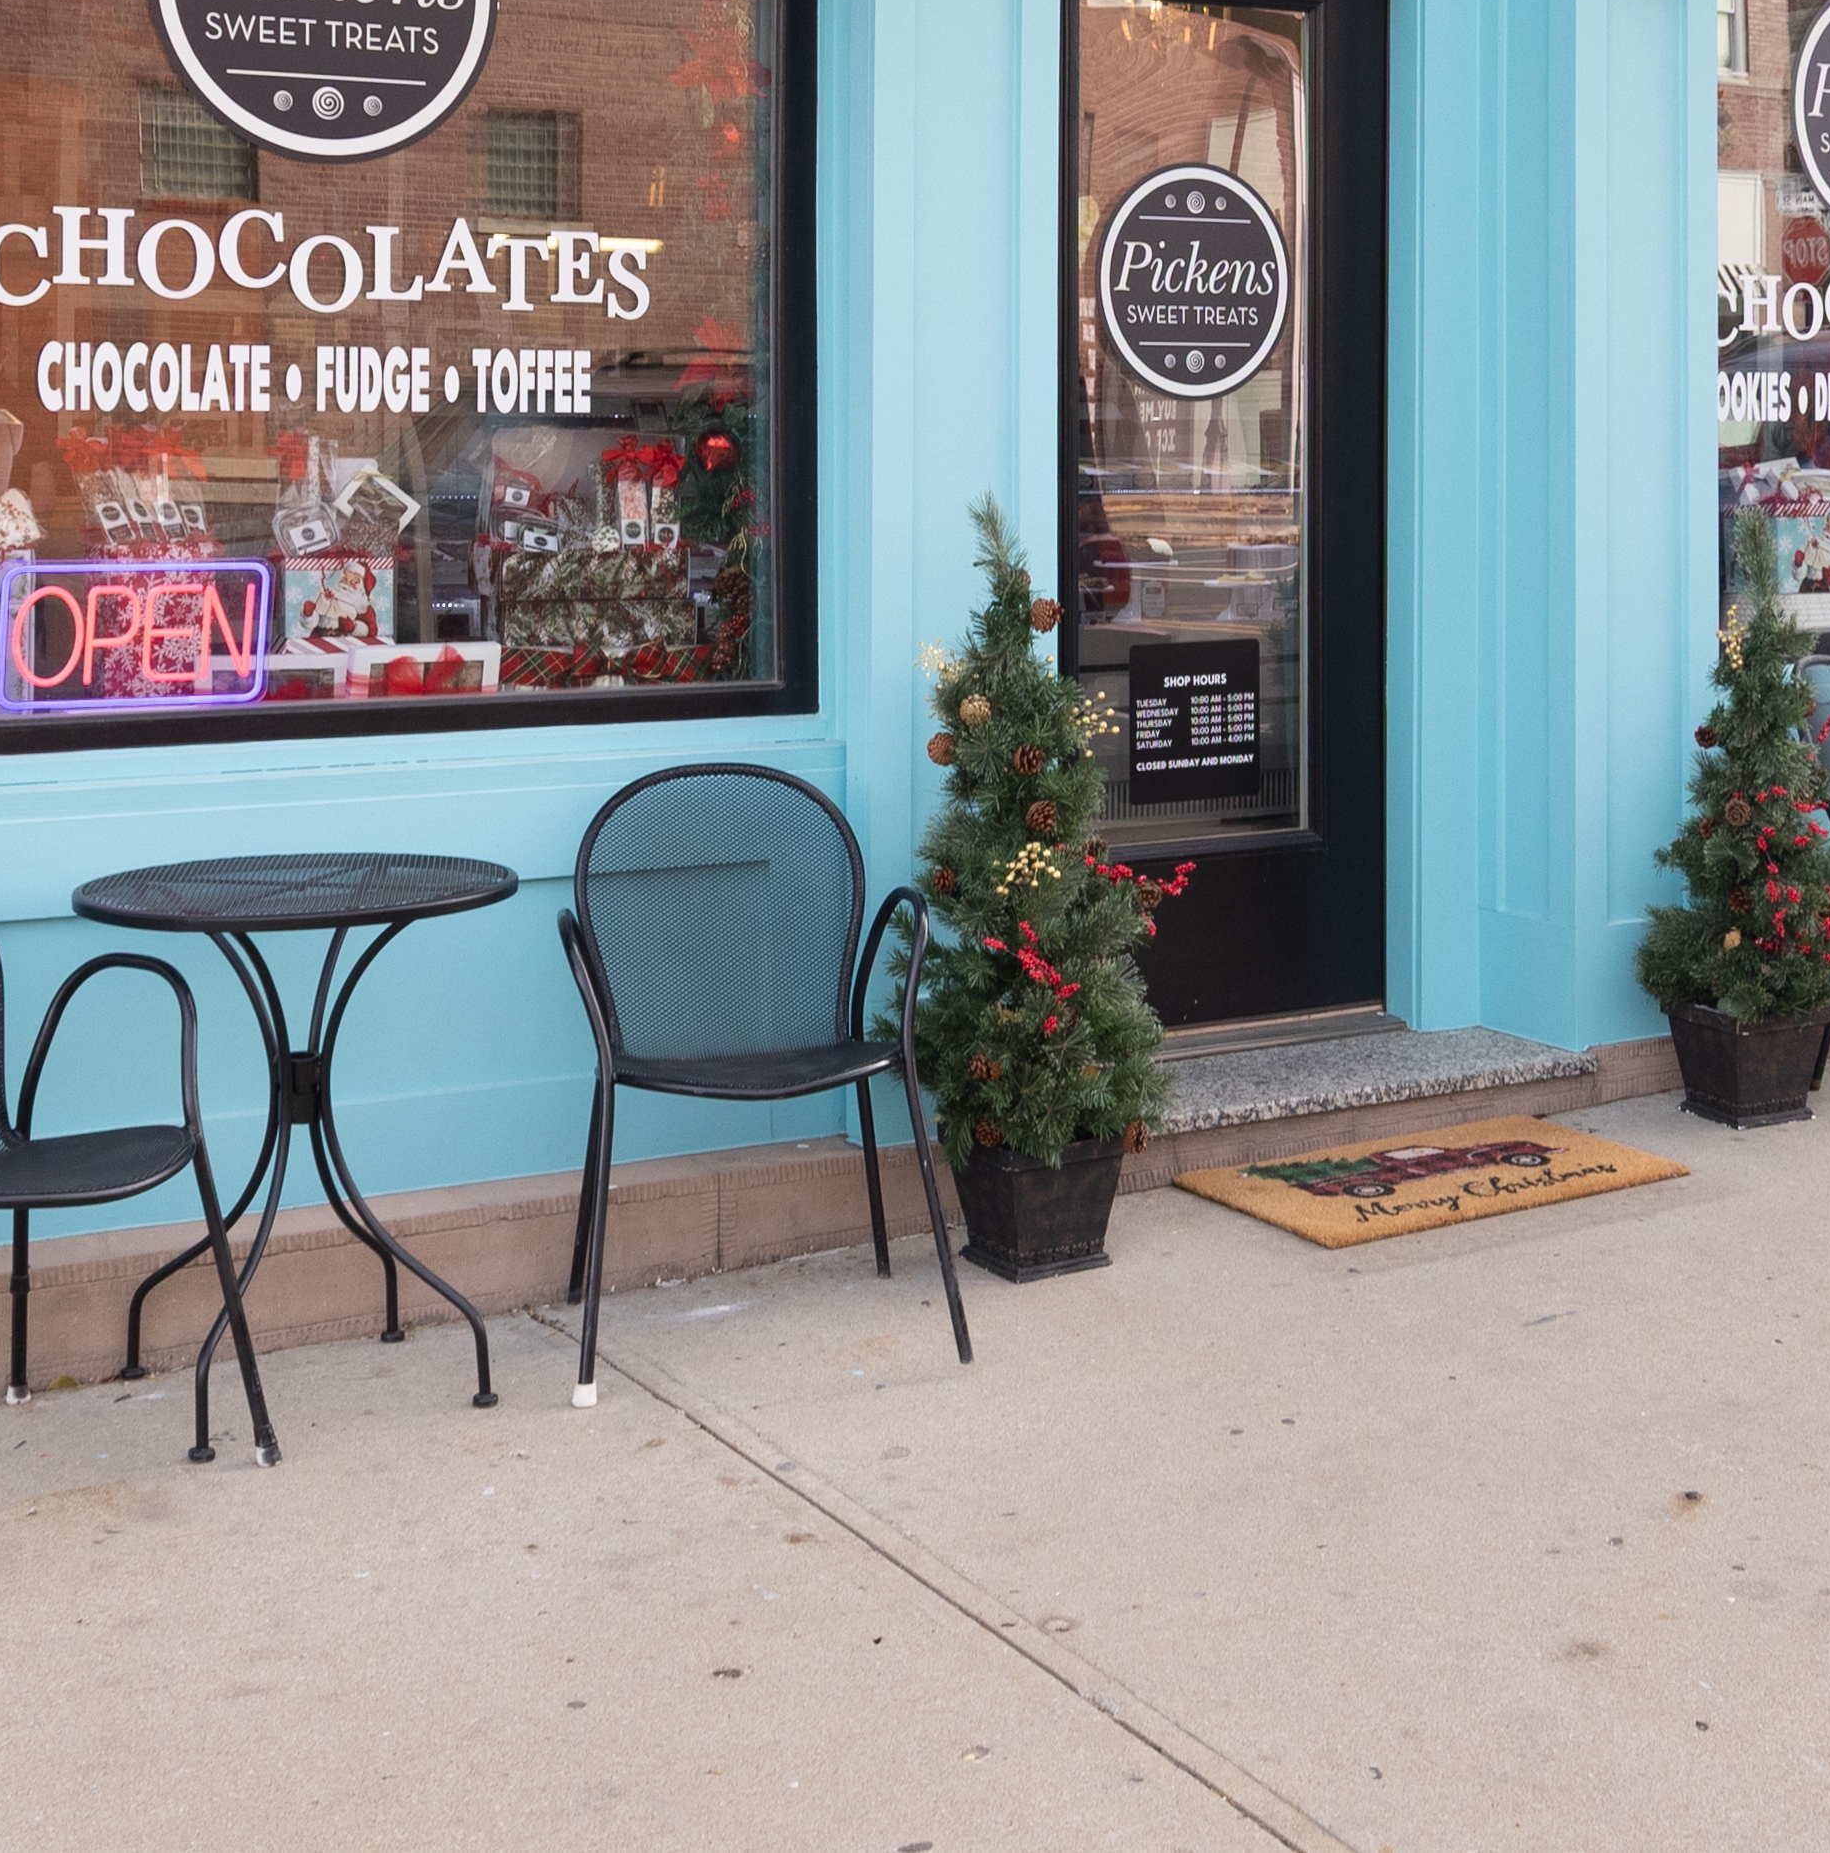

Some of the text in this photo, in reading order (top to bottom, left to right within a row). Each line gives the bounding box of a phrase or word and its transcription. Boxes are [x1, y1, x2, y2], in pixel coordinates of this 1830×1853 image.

[204, 10, 440, 57] SWEET TREATS
[1114, 240, 1276, 295] Pickens
[1126, 305, 1258, 326] SWEET TREATS
[37, 341, 592, 414] CHOCOLATE FUDGE TOFFEE
[1717, 371, 1791, 424] OOKIES
[11, 582, 256, 689] OPEN
[1164, 673, 1227, 688] SHOP HOURS
[1136, 692, 1254, 708] TUESDAY 10:00 AM 5:00 PM
[1136, 703, 1254, 718] WEDNESDAY 10:00 AM 5:00 PM
[1191, 717, 1209, 725] 10:00
[1210, 715, 1221, 723] AM
[1227, 714, 1242, 722] 5:00
[1244, 713, 1254, 721] PM
[1136, 729, 1160, 739] FRIDAY
[1191, 727, 1209, 735] 10:00
[1228, 724, 1242, 733] 5:00
[1136, 734, 1254, 750] SATURDAY 10:00 AM 4:00 PM
[1136, 754, 1254, 772] CLOSED SUNDAY AND MONDAY
[1355, 1163, 1617, 1222] Merry Christmas
